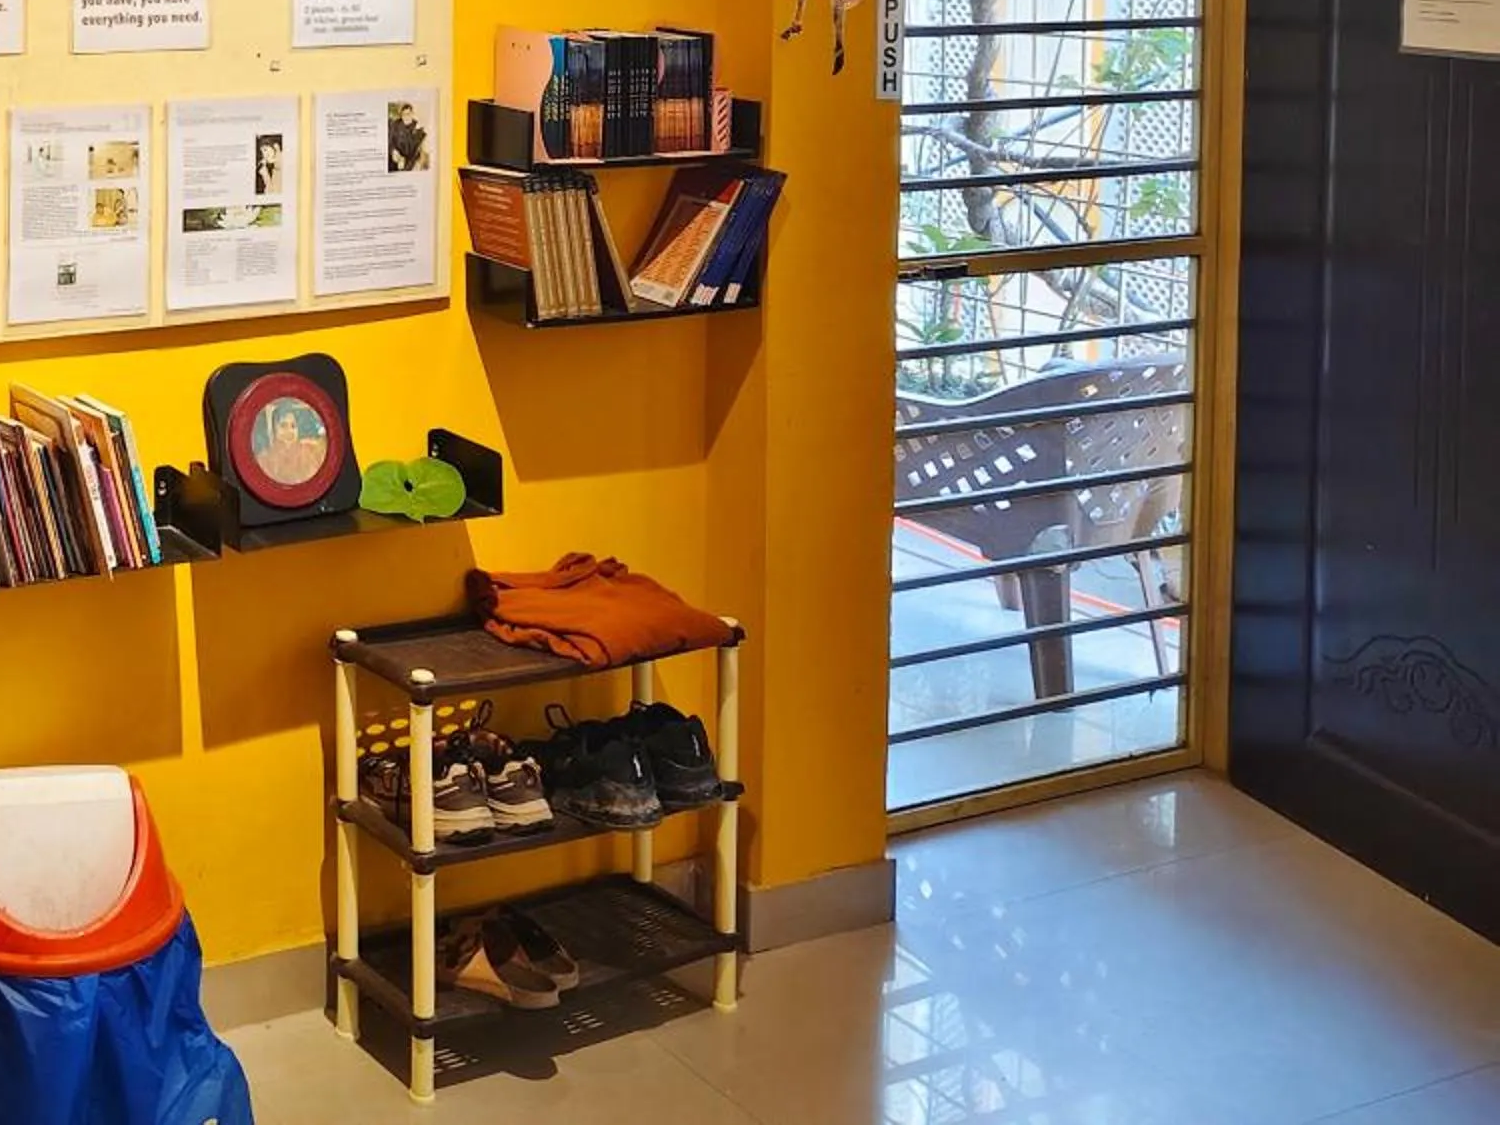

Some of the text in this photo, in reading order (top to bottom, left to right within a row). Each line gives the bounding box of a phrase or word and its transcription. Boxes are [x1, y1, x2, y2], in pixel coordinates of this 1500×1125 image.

[81, 10, 203, 29] everything you need.
